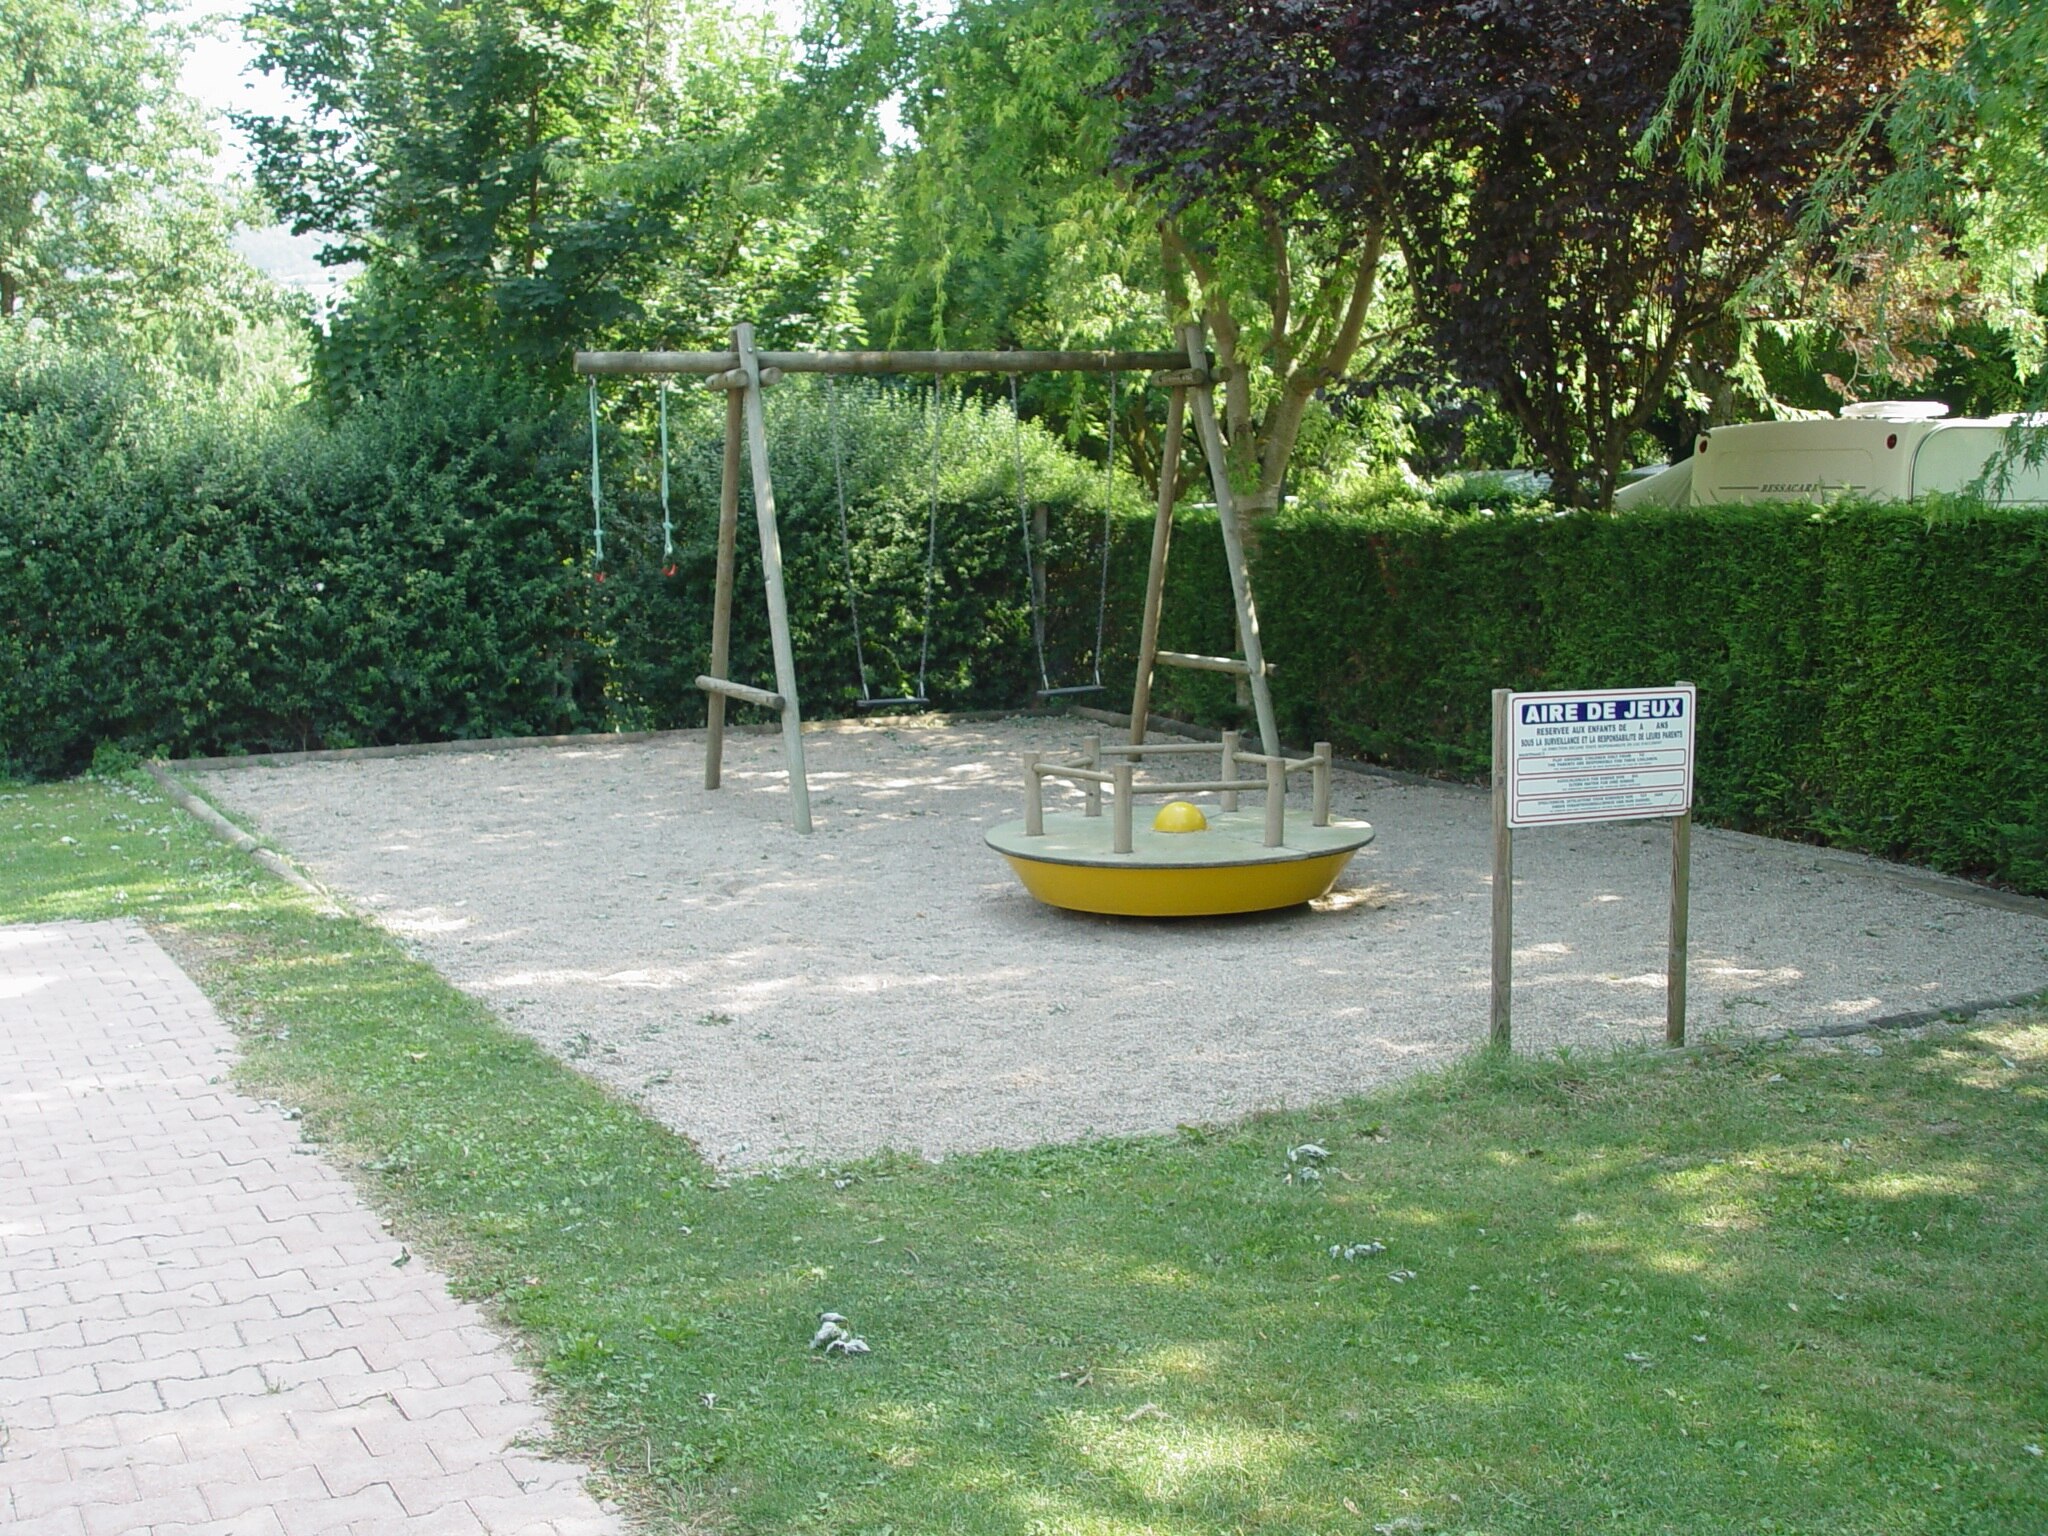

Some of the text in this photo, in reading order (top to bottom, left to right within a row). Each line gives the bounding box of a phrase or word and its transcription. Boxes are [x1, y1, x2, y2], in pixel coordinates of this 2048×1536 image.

[1525, 699, 1680, 723] AIRE DE JEUX
[1537, 727, 1569, 736] RESERVEE
[1572, 726, 1585, 734] AUX
[1588, 724, 1616, 733] ENFANTS
[1619, 724, 1627, 732] DE
[1656, 721, 1669, 729] ANS
[1521, 739, 1534, 747] SOUS
[1536, 738, 1543, 746] LA
[1544, 736, 1580, 746] SURVEILLANCE
[1582, 736, 1588, 744] ET
[1590, 735, 1596, 743] LA
[1638, 732, 1644, 740] DE
[1646, 731, 1661, 740] LEURS
[1662, 730, 1683, 739] PARENTS
